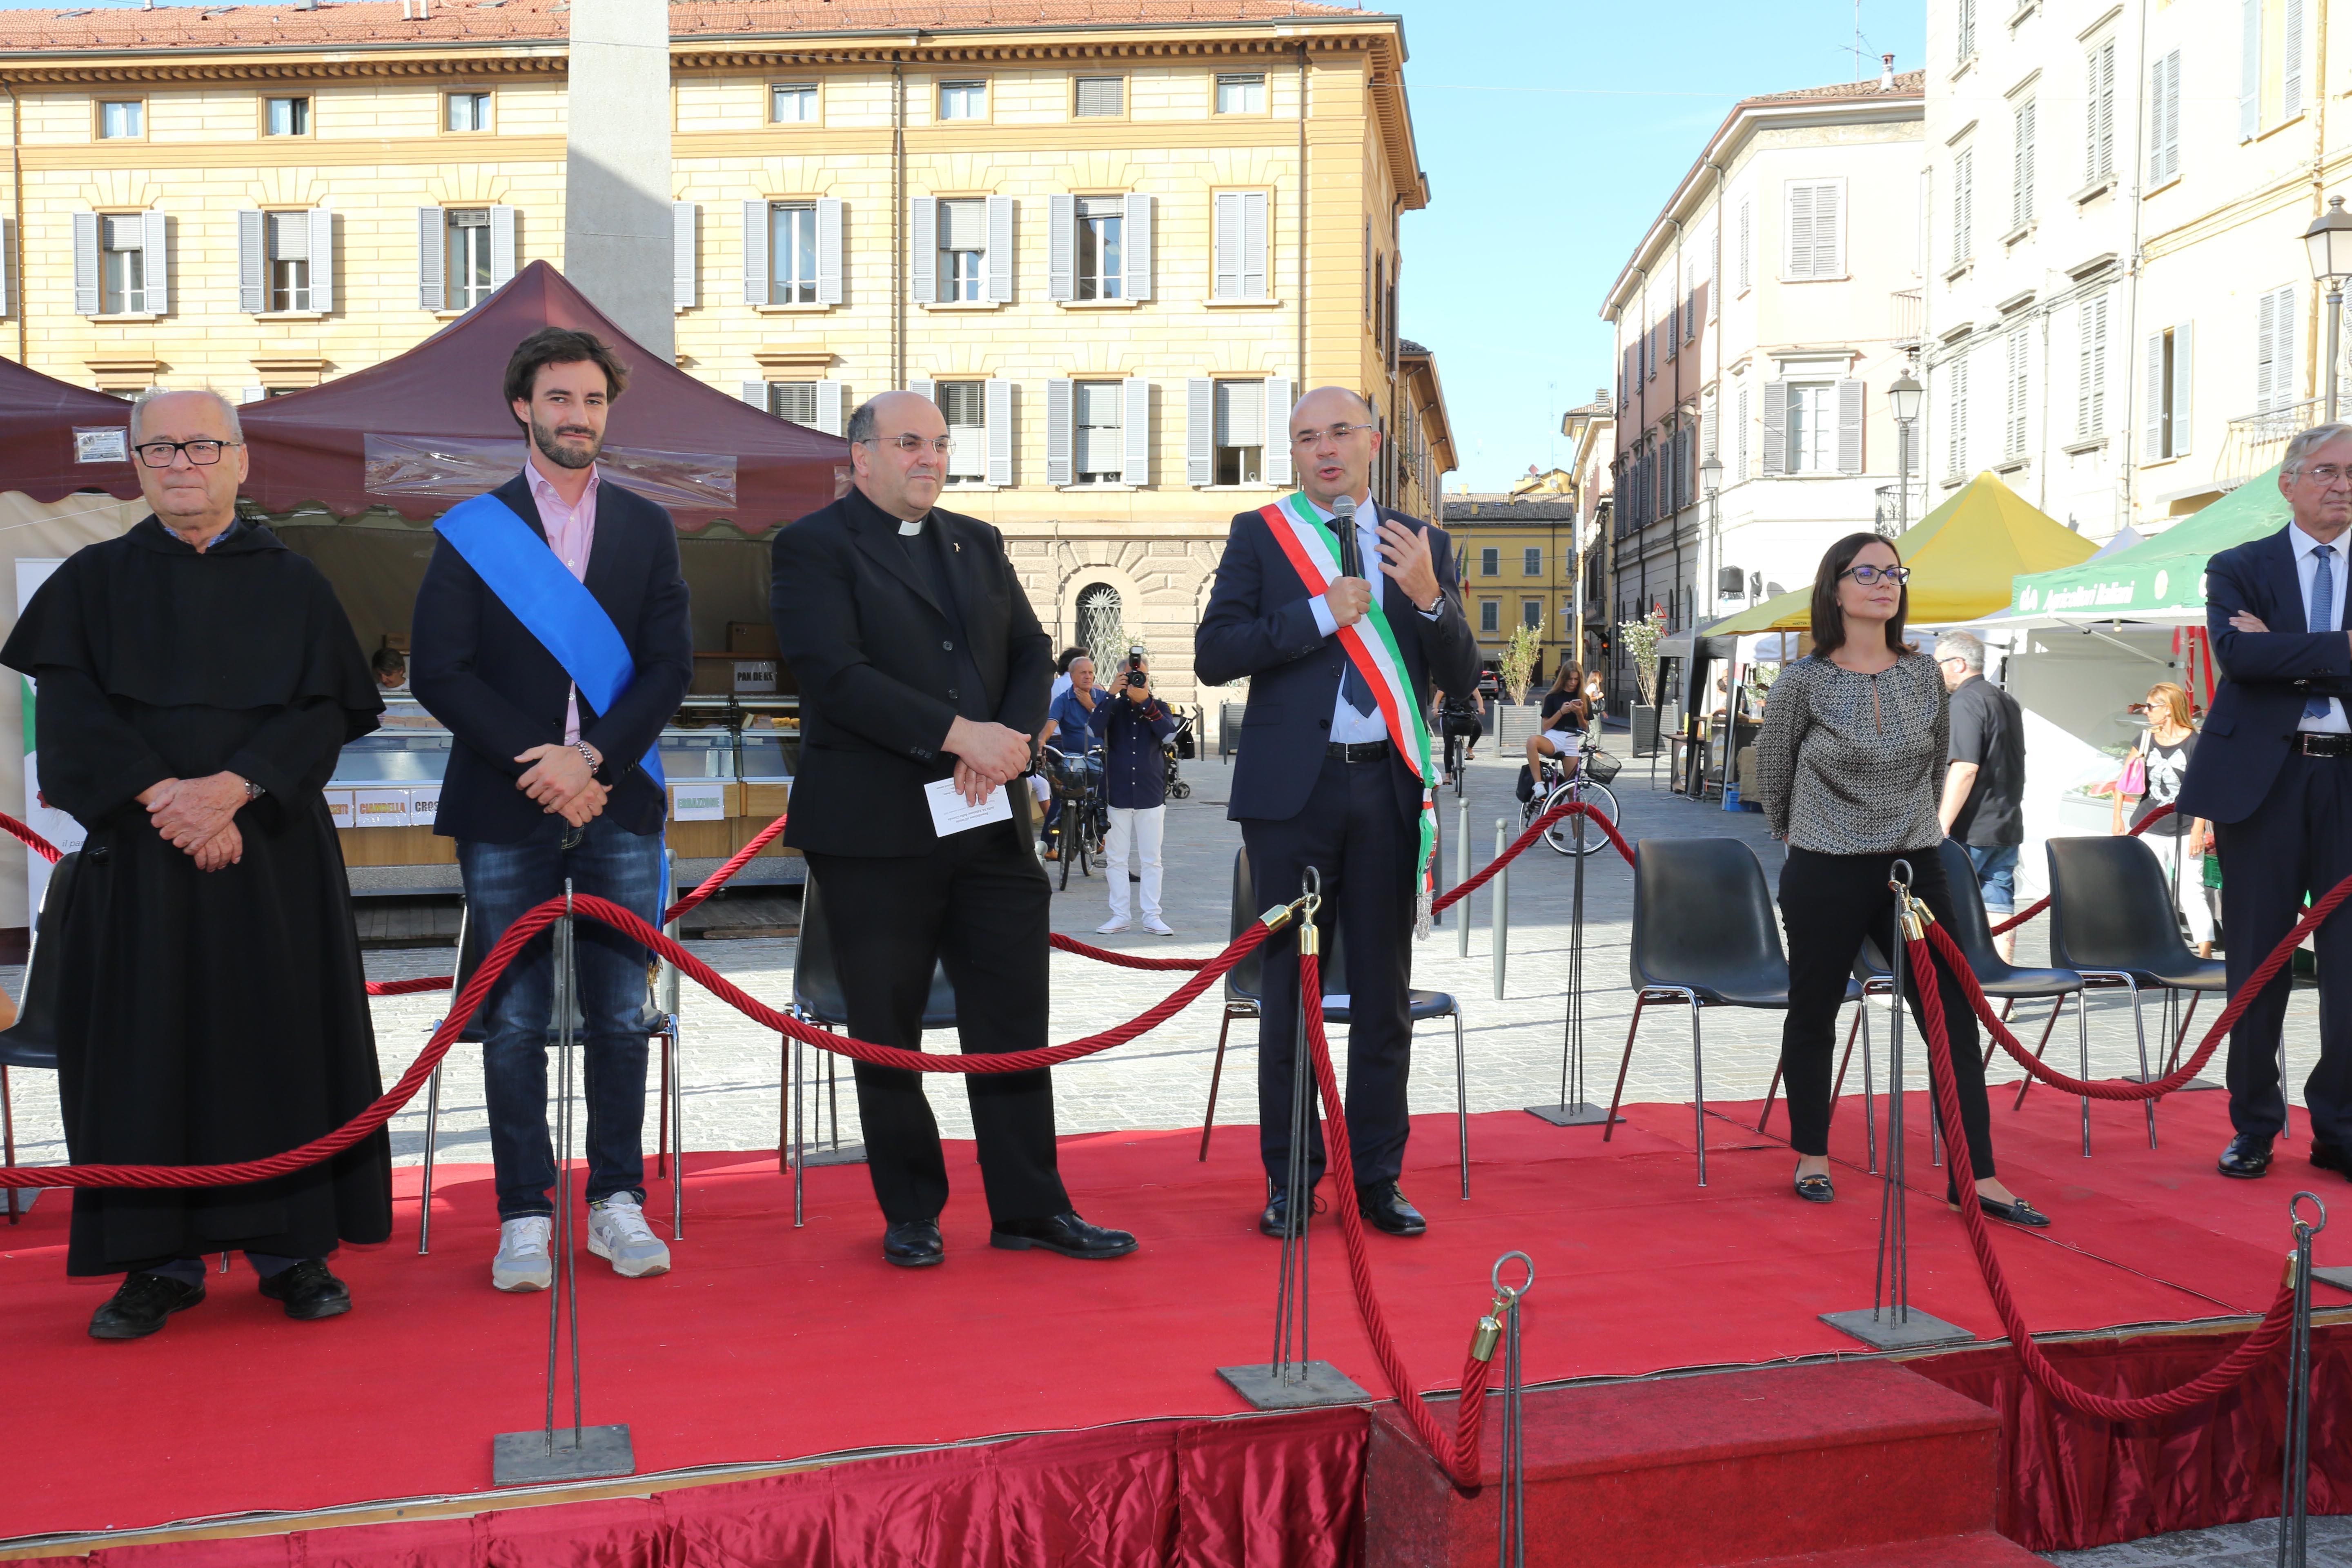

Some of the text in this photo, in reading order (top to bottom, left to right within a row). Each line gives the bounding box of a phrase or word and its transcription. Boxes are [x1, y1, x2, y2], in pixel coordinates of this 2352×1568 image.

[737, 672, 751, 681] PAN
[753, 672, 762, 681] DE
[360, 802, 406, 814] CIAMBELLA
